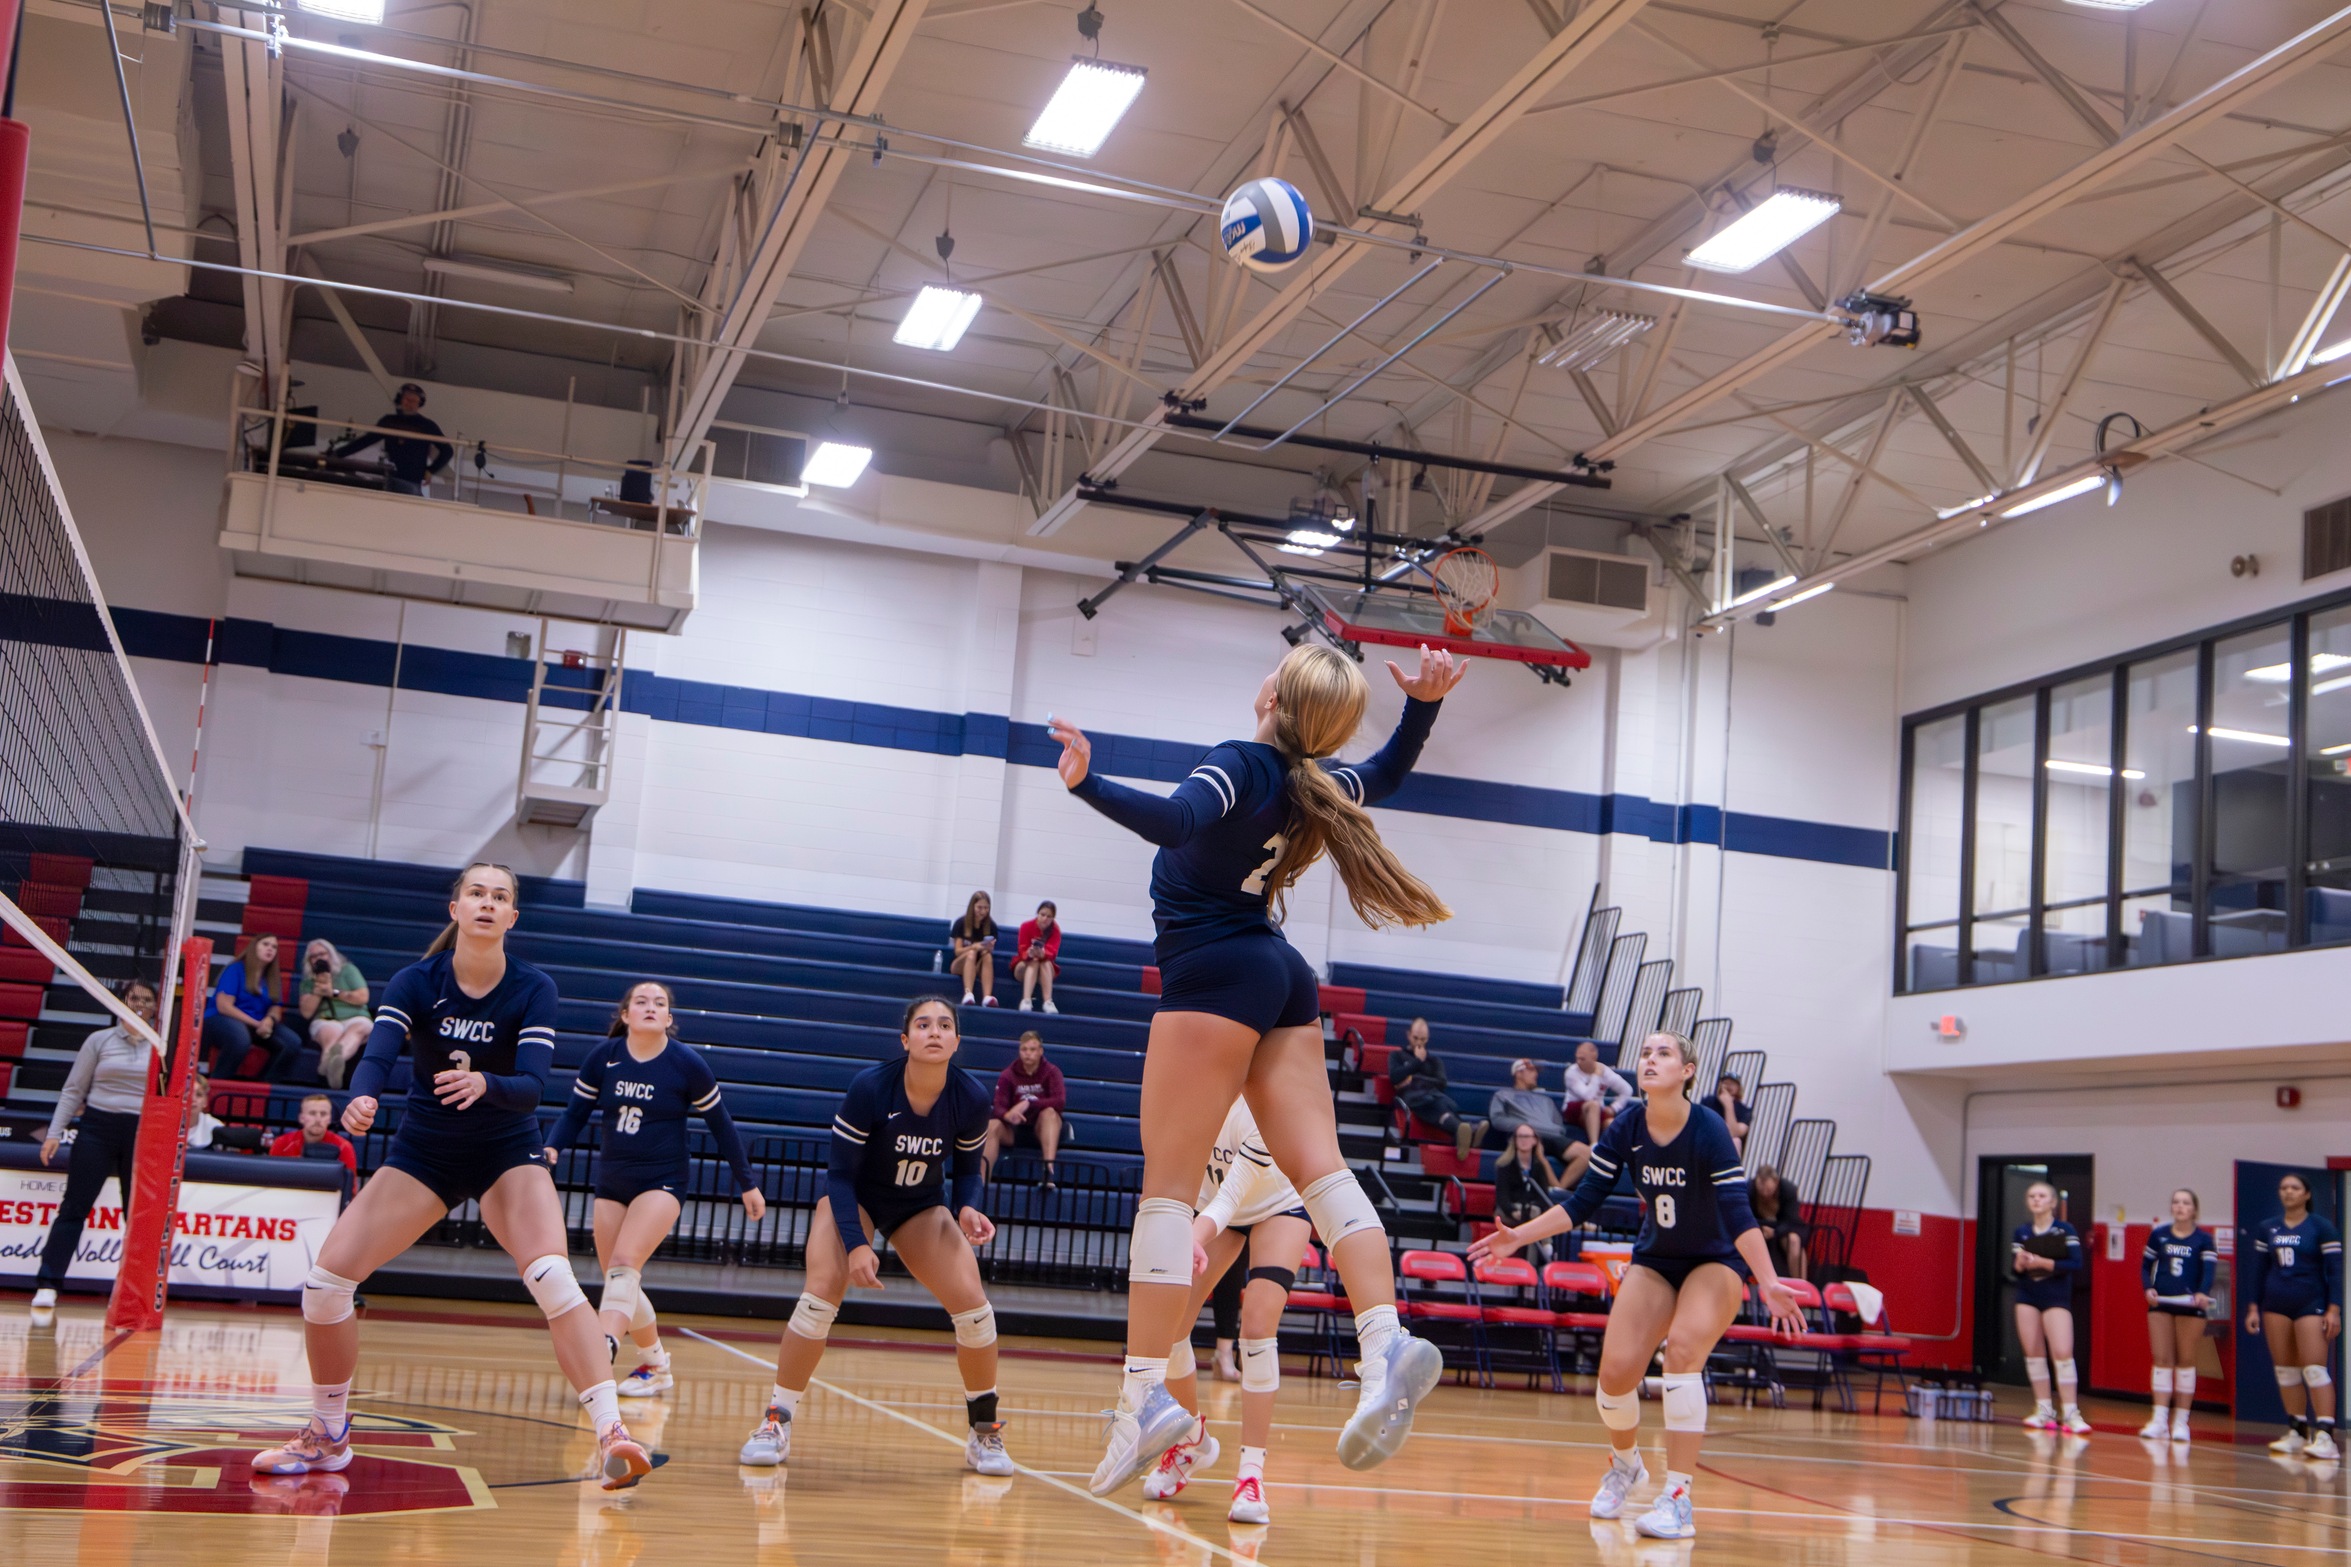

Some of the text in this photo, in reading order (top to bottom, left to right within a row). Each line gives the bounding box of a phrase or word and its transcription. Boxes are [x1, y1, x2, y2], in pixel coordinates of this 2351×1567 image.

[439, 1016, 495, 1042] SWCC
[614, 1080, 655, 1100] SWCC
[616, 1105, 643, 1135] 16
[895, 1134, 943, 1155] SWCC
[895, 1159, 928, 1186] 10
[1642, 1165, 1686, 1187] SWCC
[20, 1180, 56, 1192] HOME
[1655, 1194, 1677, 1228] 8
[2166, 1243, 2193, 1257] SWCC
[2274, 1234, 2301, 1246] SWCC
[199, 1245, 269, 1273] Court
[2171, 1257, 2184, 1277] 5
